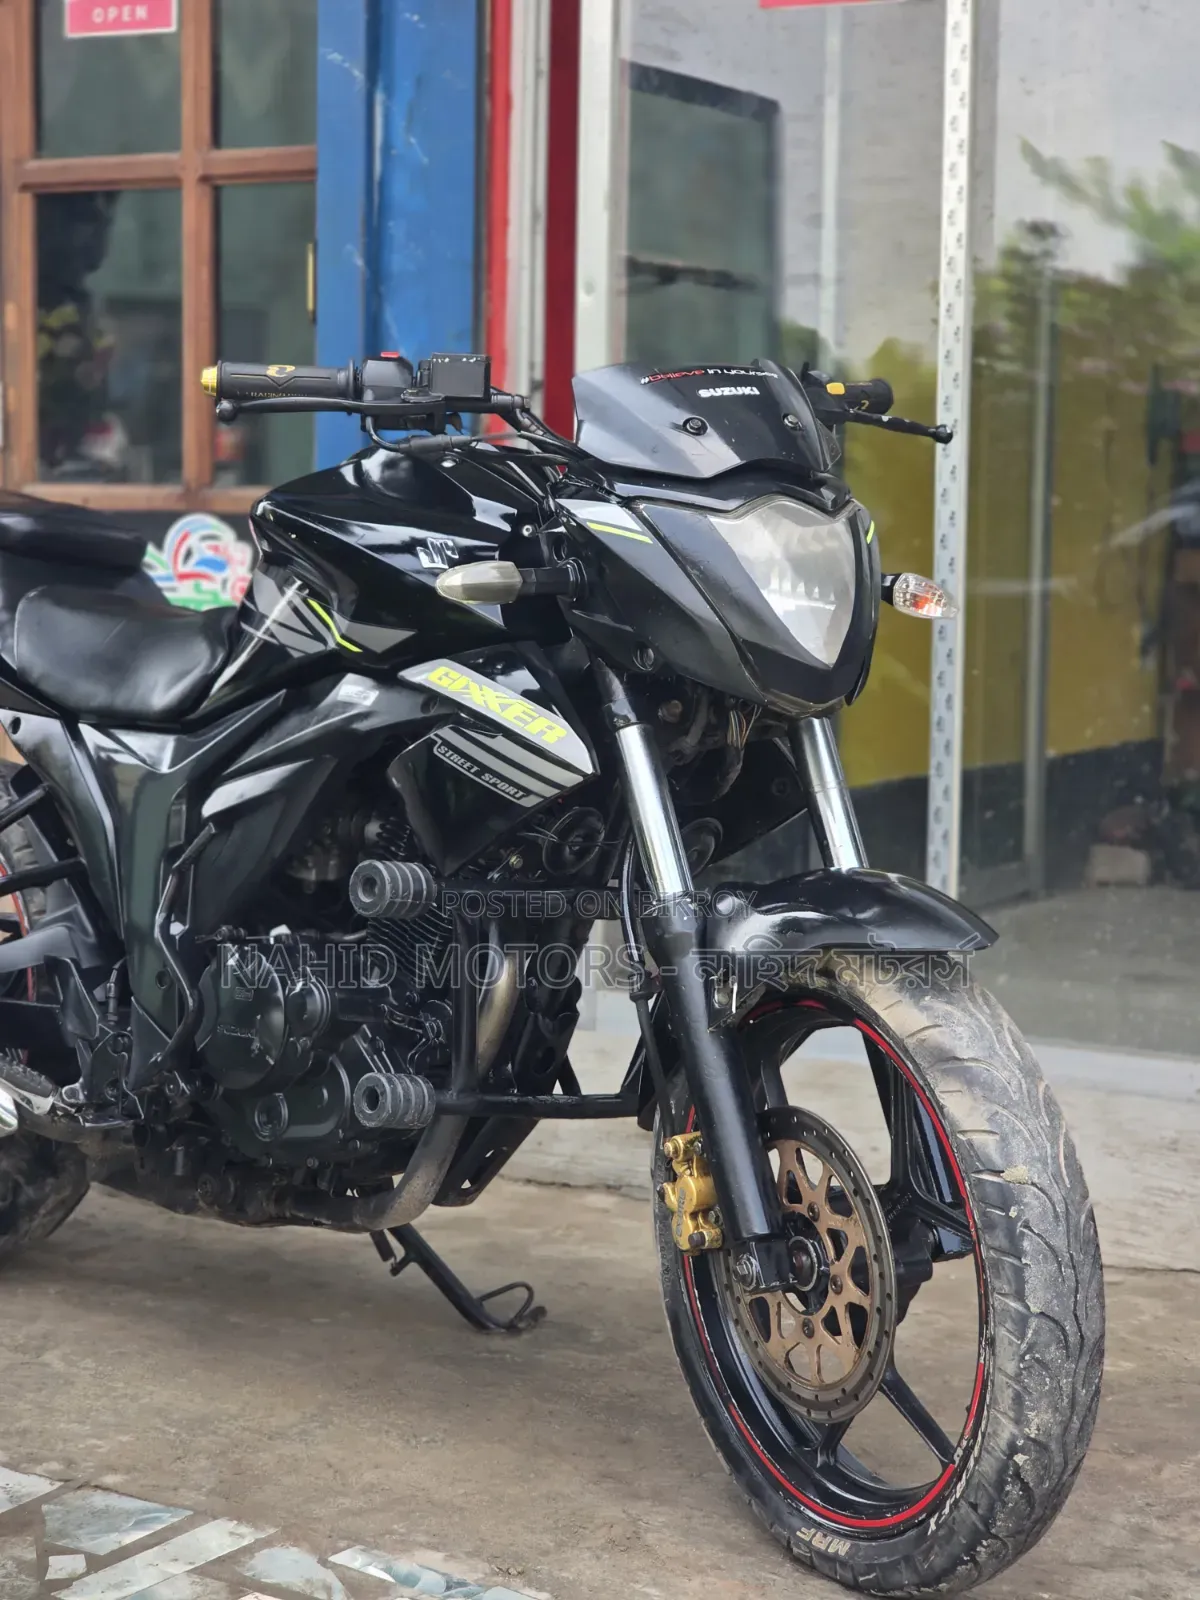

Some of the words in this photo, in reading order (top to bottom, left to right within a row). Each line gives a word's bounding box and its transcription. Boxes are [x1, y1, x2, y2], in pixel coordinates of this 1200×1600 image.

[91, 4, 148, 24] OPEN
[698, 386, 760, 398] SUZUKI
[427, 666, 568, 744] GIXXER
[437, 745, 481, 774] STREET
[481, 772, 527, 799] SPORT
[795, 1526, 852, 1557] MRF
